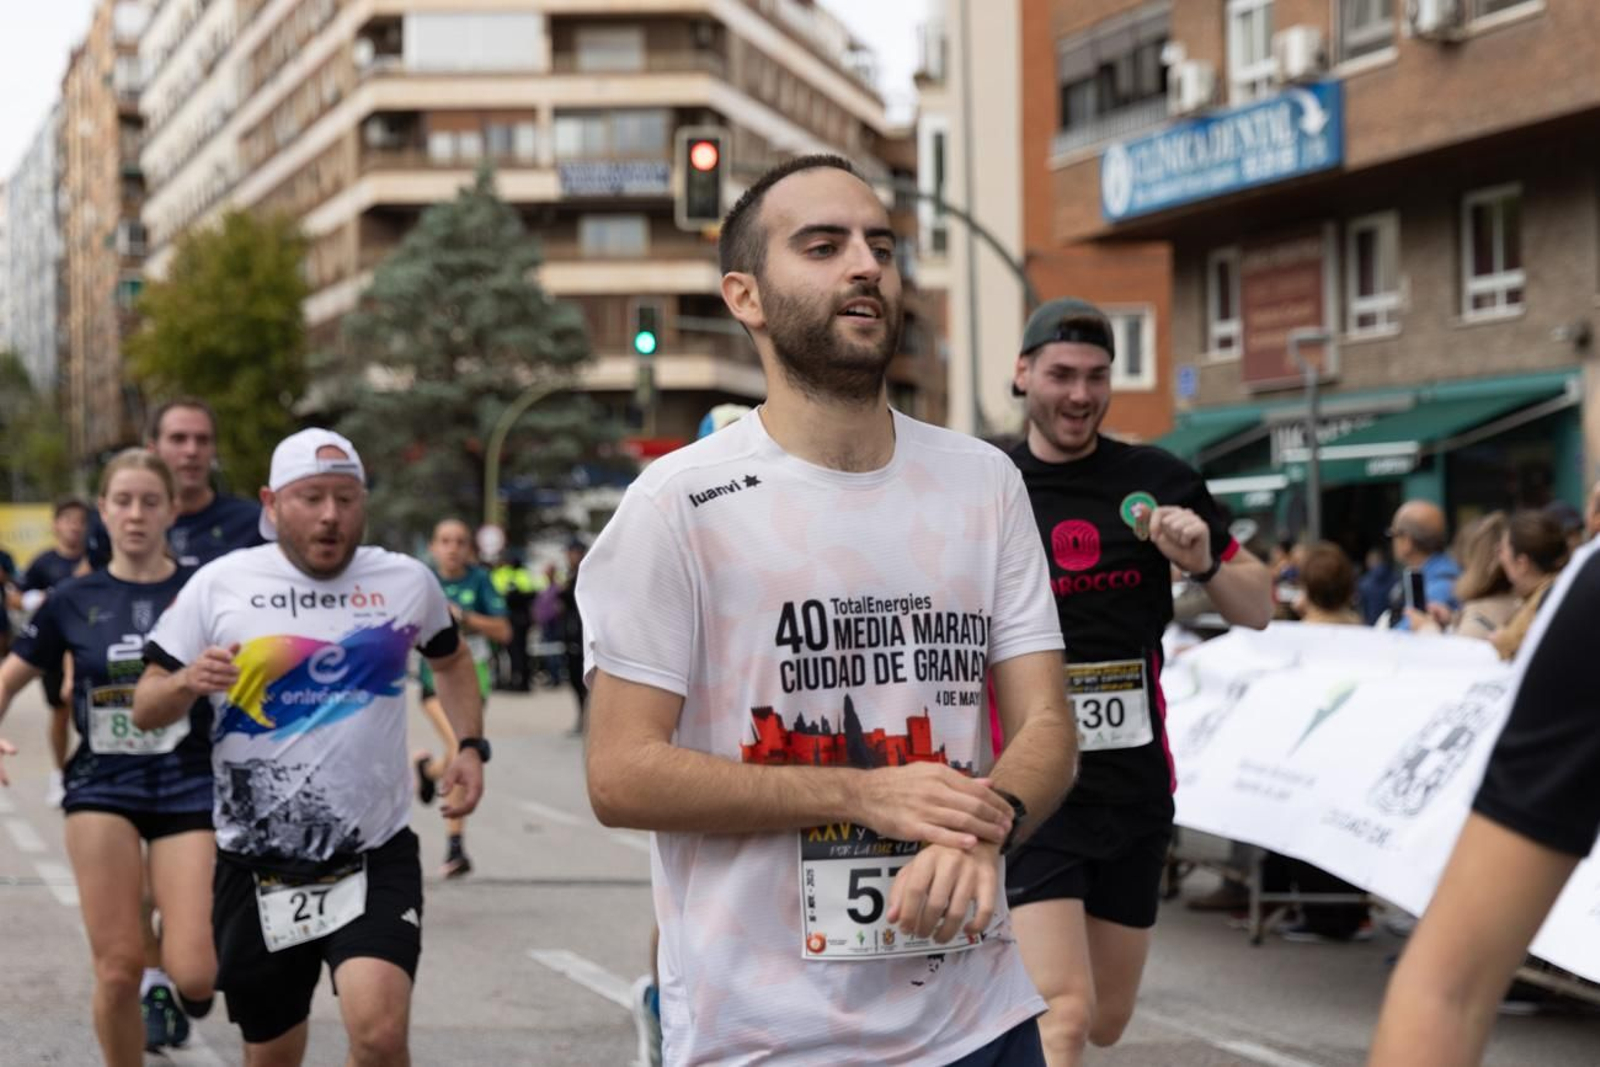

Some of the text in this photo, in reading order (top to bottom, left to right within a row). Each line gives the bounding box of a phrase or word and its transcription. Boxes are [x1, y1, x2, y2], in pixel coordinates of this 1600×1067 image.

[689, 479, 742, 507] luanvi
[1050, 569, 1142, 596] ROCCO
[830, 593, 932, 616] TotalEnergies
[775, 599, 829, 653] 40
[833, 615, 906, 650] MEDIA
[780, 654, 866, 694] CIUDAD
[873, 651, 907, 686] DE
[943, 690, 956, 706] DE
[1076, 697, 1125, 729] 30
[290, 891, 332, 922] 27
[847, 867, 902, 924] 5
